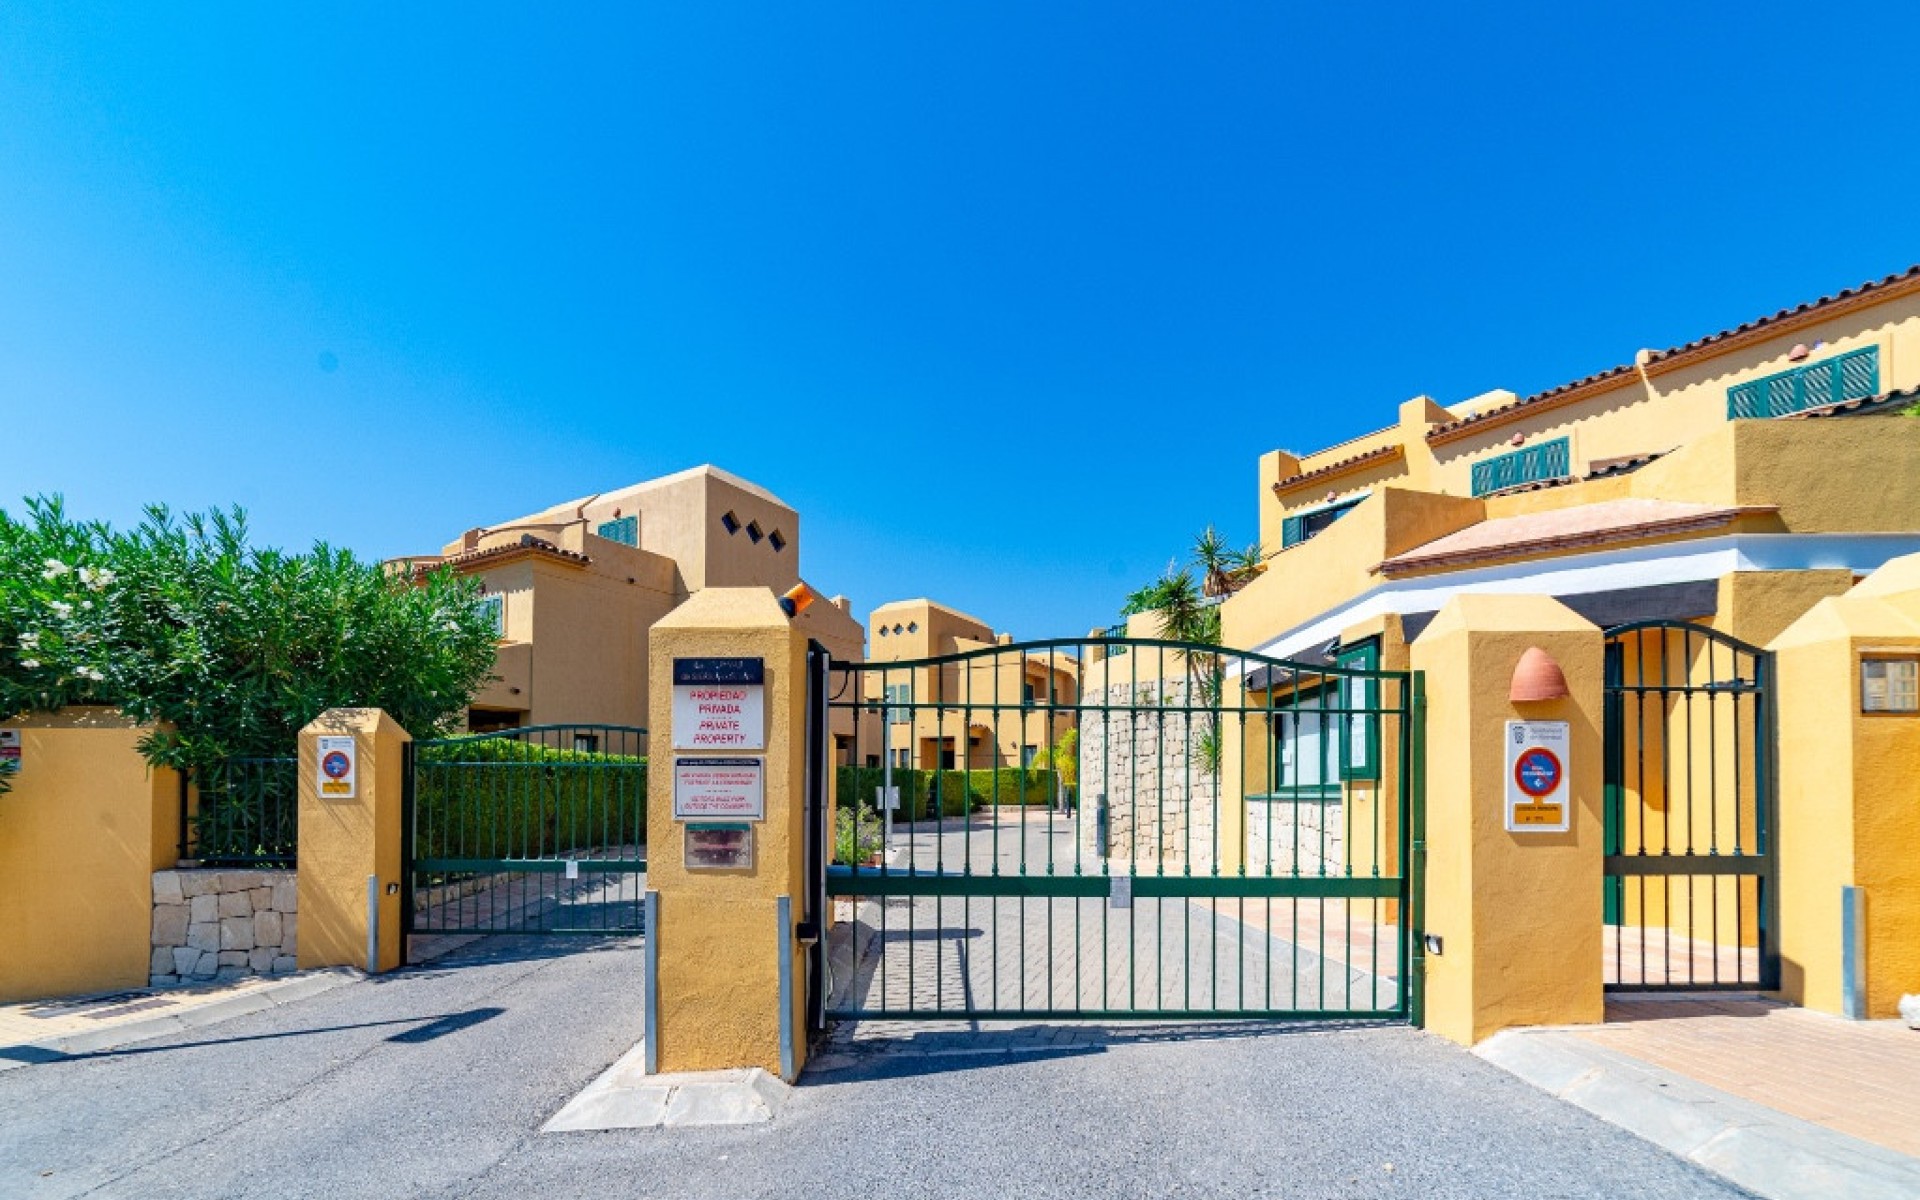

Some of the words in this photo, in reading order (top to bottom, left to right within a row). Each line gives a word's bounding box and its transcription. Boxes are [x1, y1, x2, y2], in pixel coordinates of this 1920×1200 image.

[689, 690, 747, 701] PROPIEDAD
[698, 704, 741, 714] PRIVADA
[698, 720, 740, 731] PRIVATE
[693, 733, 747, 744] PROPERTY
